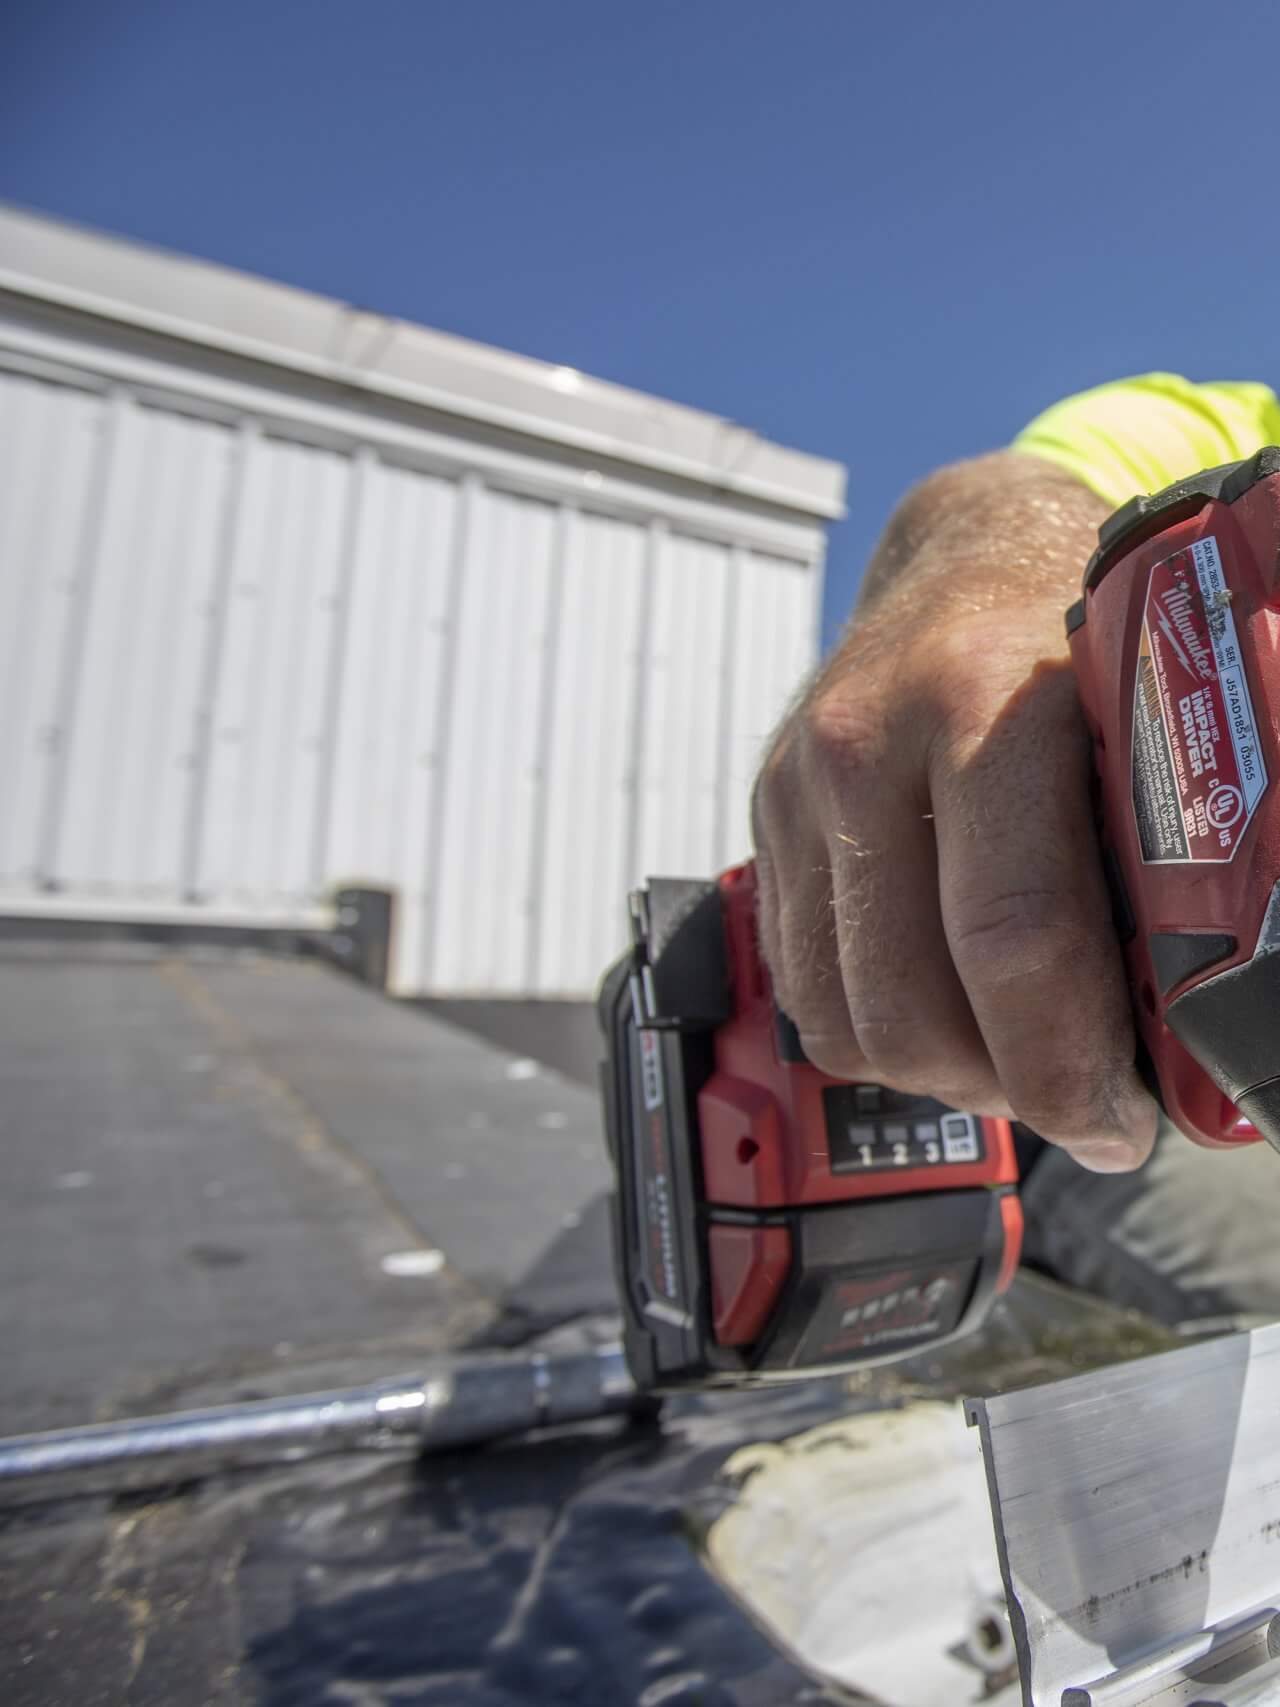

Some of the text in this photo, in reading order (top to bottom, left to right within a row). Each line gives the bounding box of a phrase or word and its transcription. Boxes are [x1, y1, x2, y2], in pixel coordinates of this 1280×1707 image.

[1208, 569, 1221, 595] 2853-2
[1159, 581, 1212, 679] Milwaukee
[1225, 645, 1255, 780] SER. J57AD1851 03055
[1178, 695, 1203, 778] DRIVER
[1190, 690, 1217, 769] IMPACT
[1210, 727, 1220, 742] HEX
[1152, 717, 1182, 854] To reduce the risk of injury, user
[1178, 774, 1188, 795] USA
[1160, 807, 1168, 828] Use
[1183, 808, 1197, 837] 9R31
[1192, 795, 1209, 836] LISTED
[1163, 828, 1172, 847] only
[1218, 829, 1231, 847] US
[859, 1144, 873, 1166] 1
[893, 1142, 908, 1165] 2
[925, 1140, 940, 1163] 3
